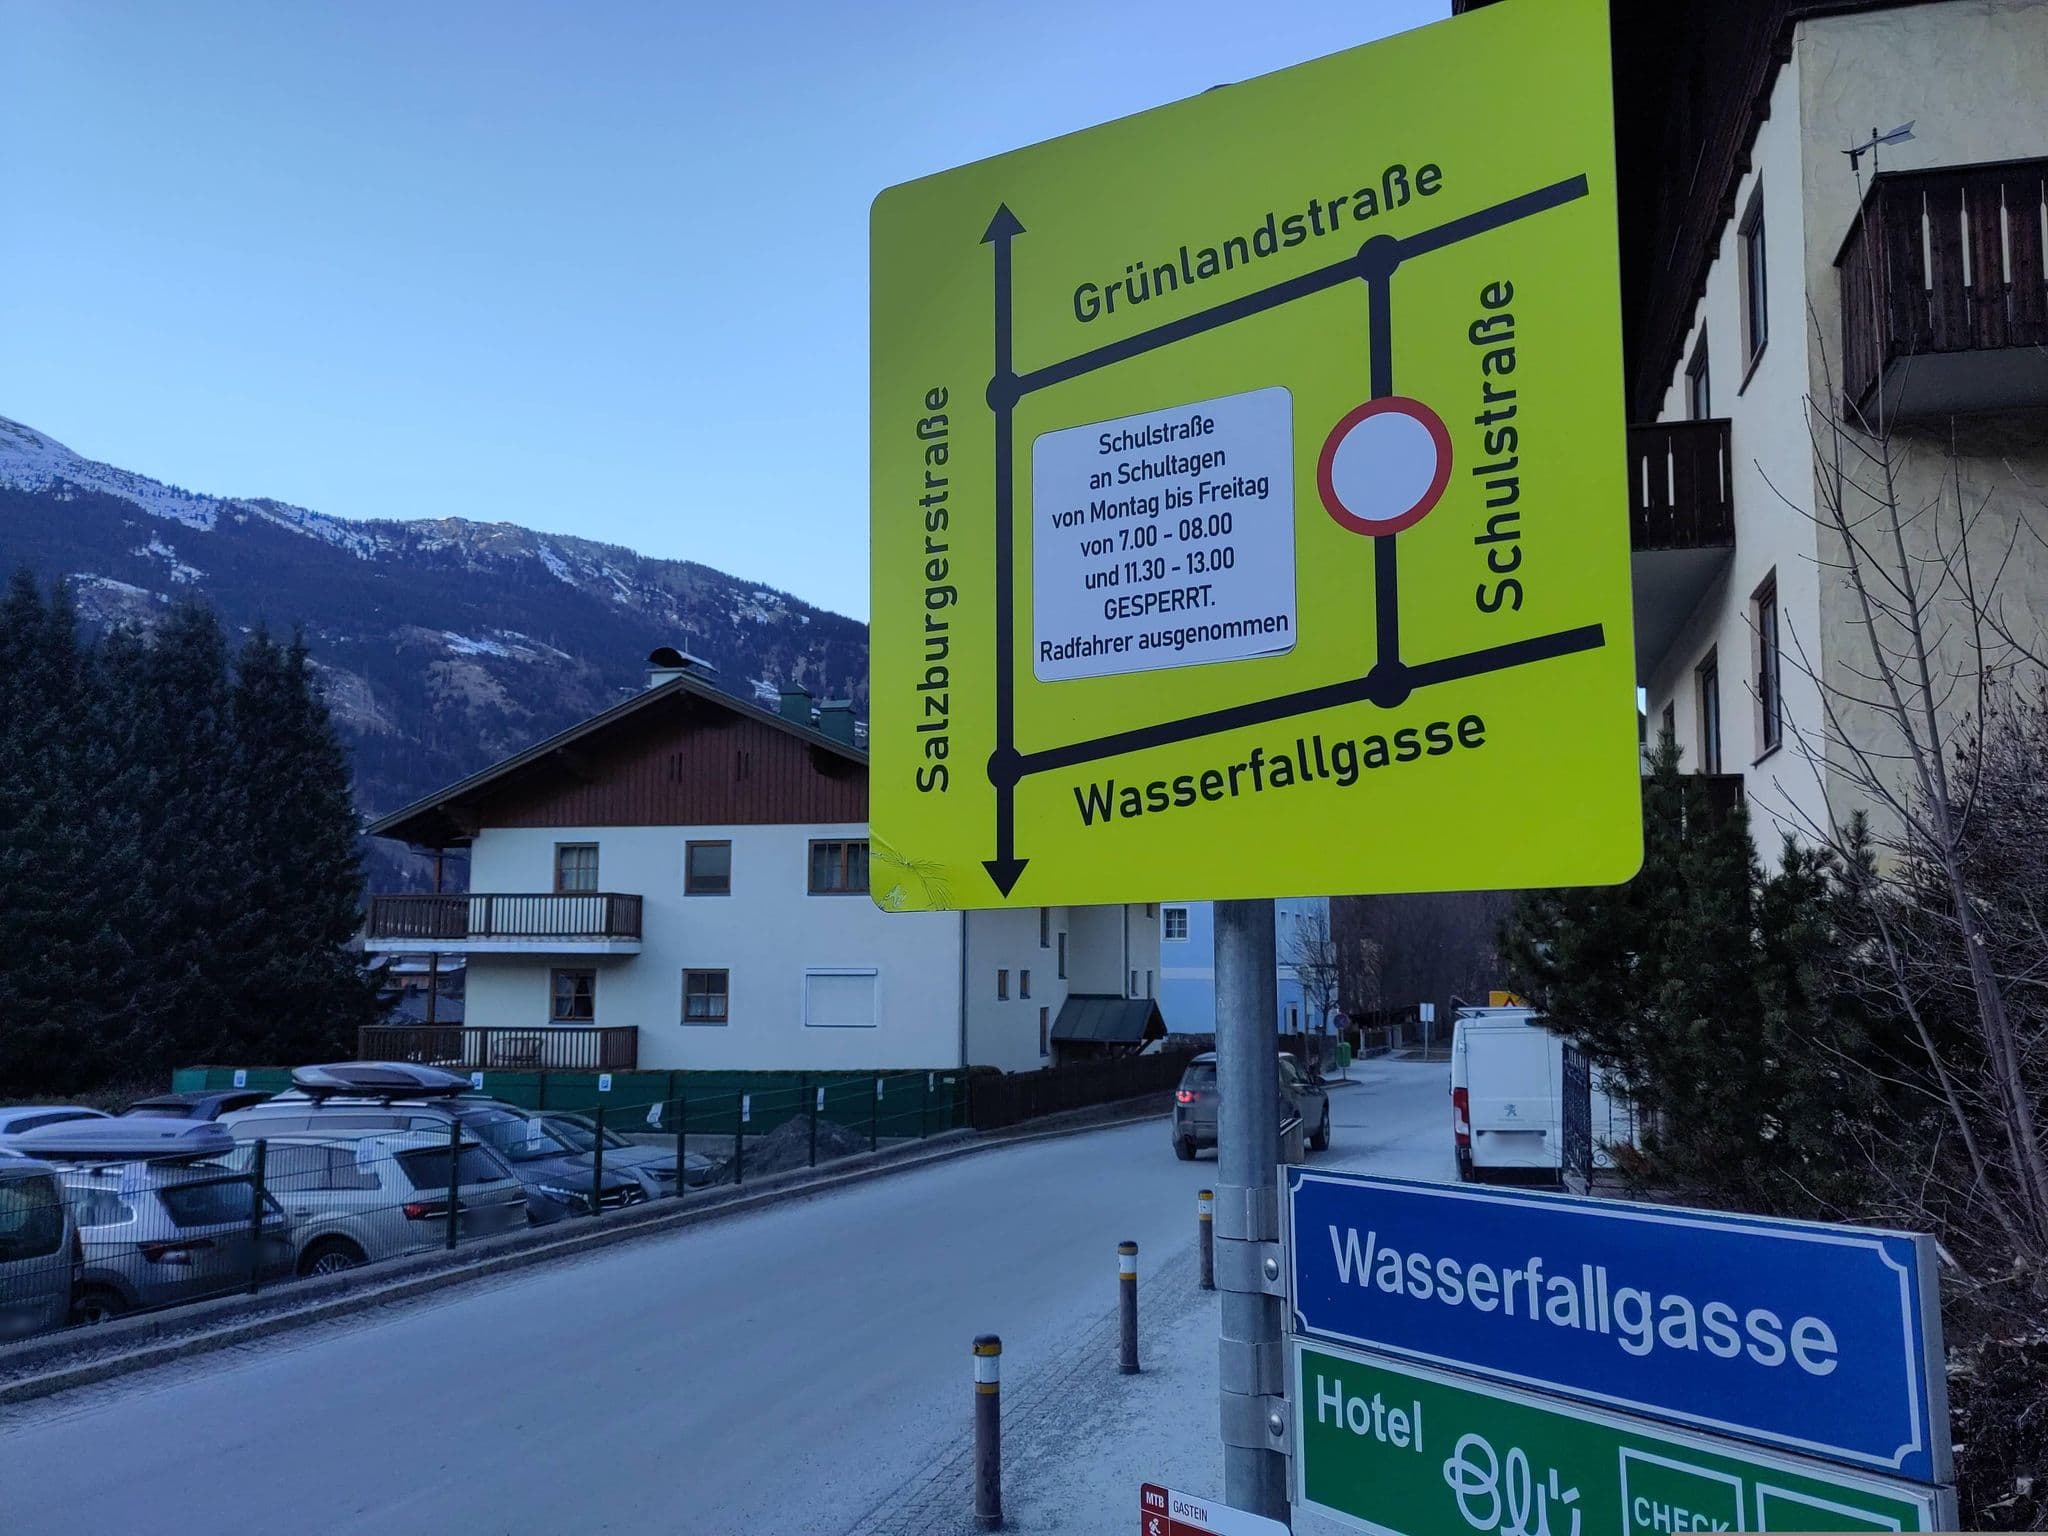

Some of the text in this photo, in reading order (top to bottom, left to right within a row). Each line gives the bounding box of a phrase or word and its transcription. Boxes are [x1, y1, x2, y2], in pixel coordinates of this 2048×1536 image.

[1074, 163, 1443, 323] Grünlandstraße
[1099, 415, 1215, 455] Schulstraße
[1468, 279, 1524, 614] Schulstraße
[1090, 450, 1226, 490] an Schultagen
[1052, 476, 1269, 529] von Montag bis Freitag
[1080, 537, 1114, 557] von
[1119, 525, 1157, 551] 7.00
[1179, 512, 1233, 542] 08.00
[916, 386, 958, 793] Salzburgerstraße
[1085, 566, 1119, 589] und
[1124, 557, 1165, 584] 11.30
[1187, 547, 1235, 575] 13.00
[1104, 585, 1216, 620] GESPERRT.
[1040, 613, 1290, 662] Radfahrer ausgenommen
[1074, 714, 1486, 827] Wasserfallgasse
[1329, 1225, 1838, 1375] Wasserfallgasse
[1317, 1374, 1423, 1453] Hotel
[1145, 1491, 1165, 1508] MTB
[1173, 1500, 1208, 1522] GASTEIN
